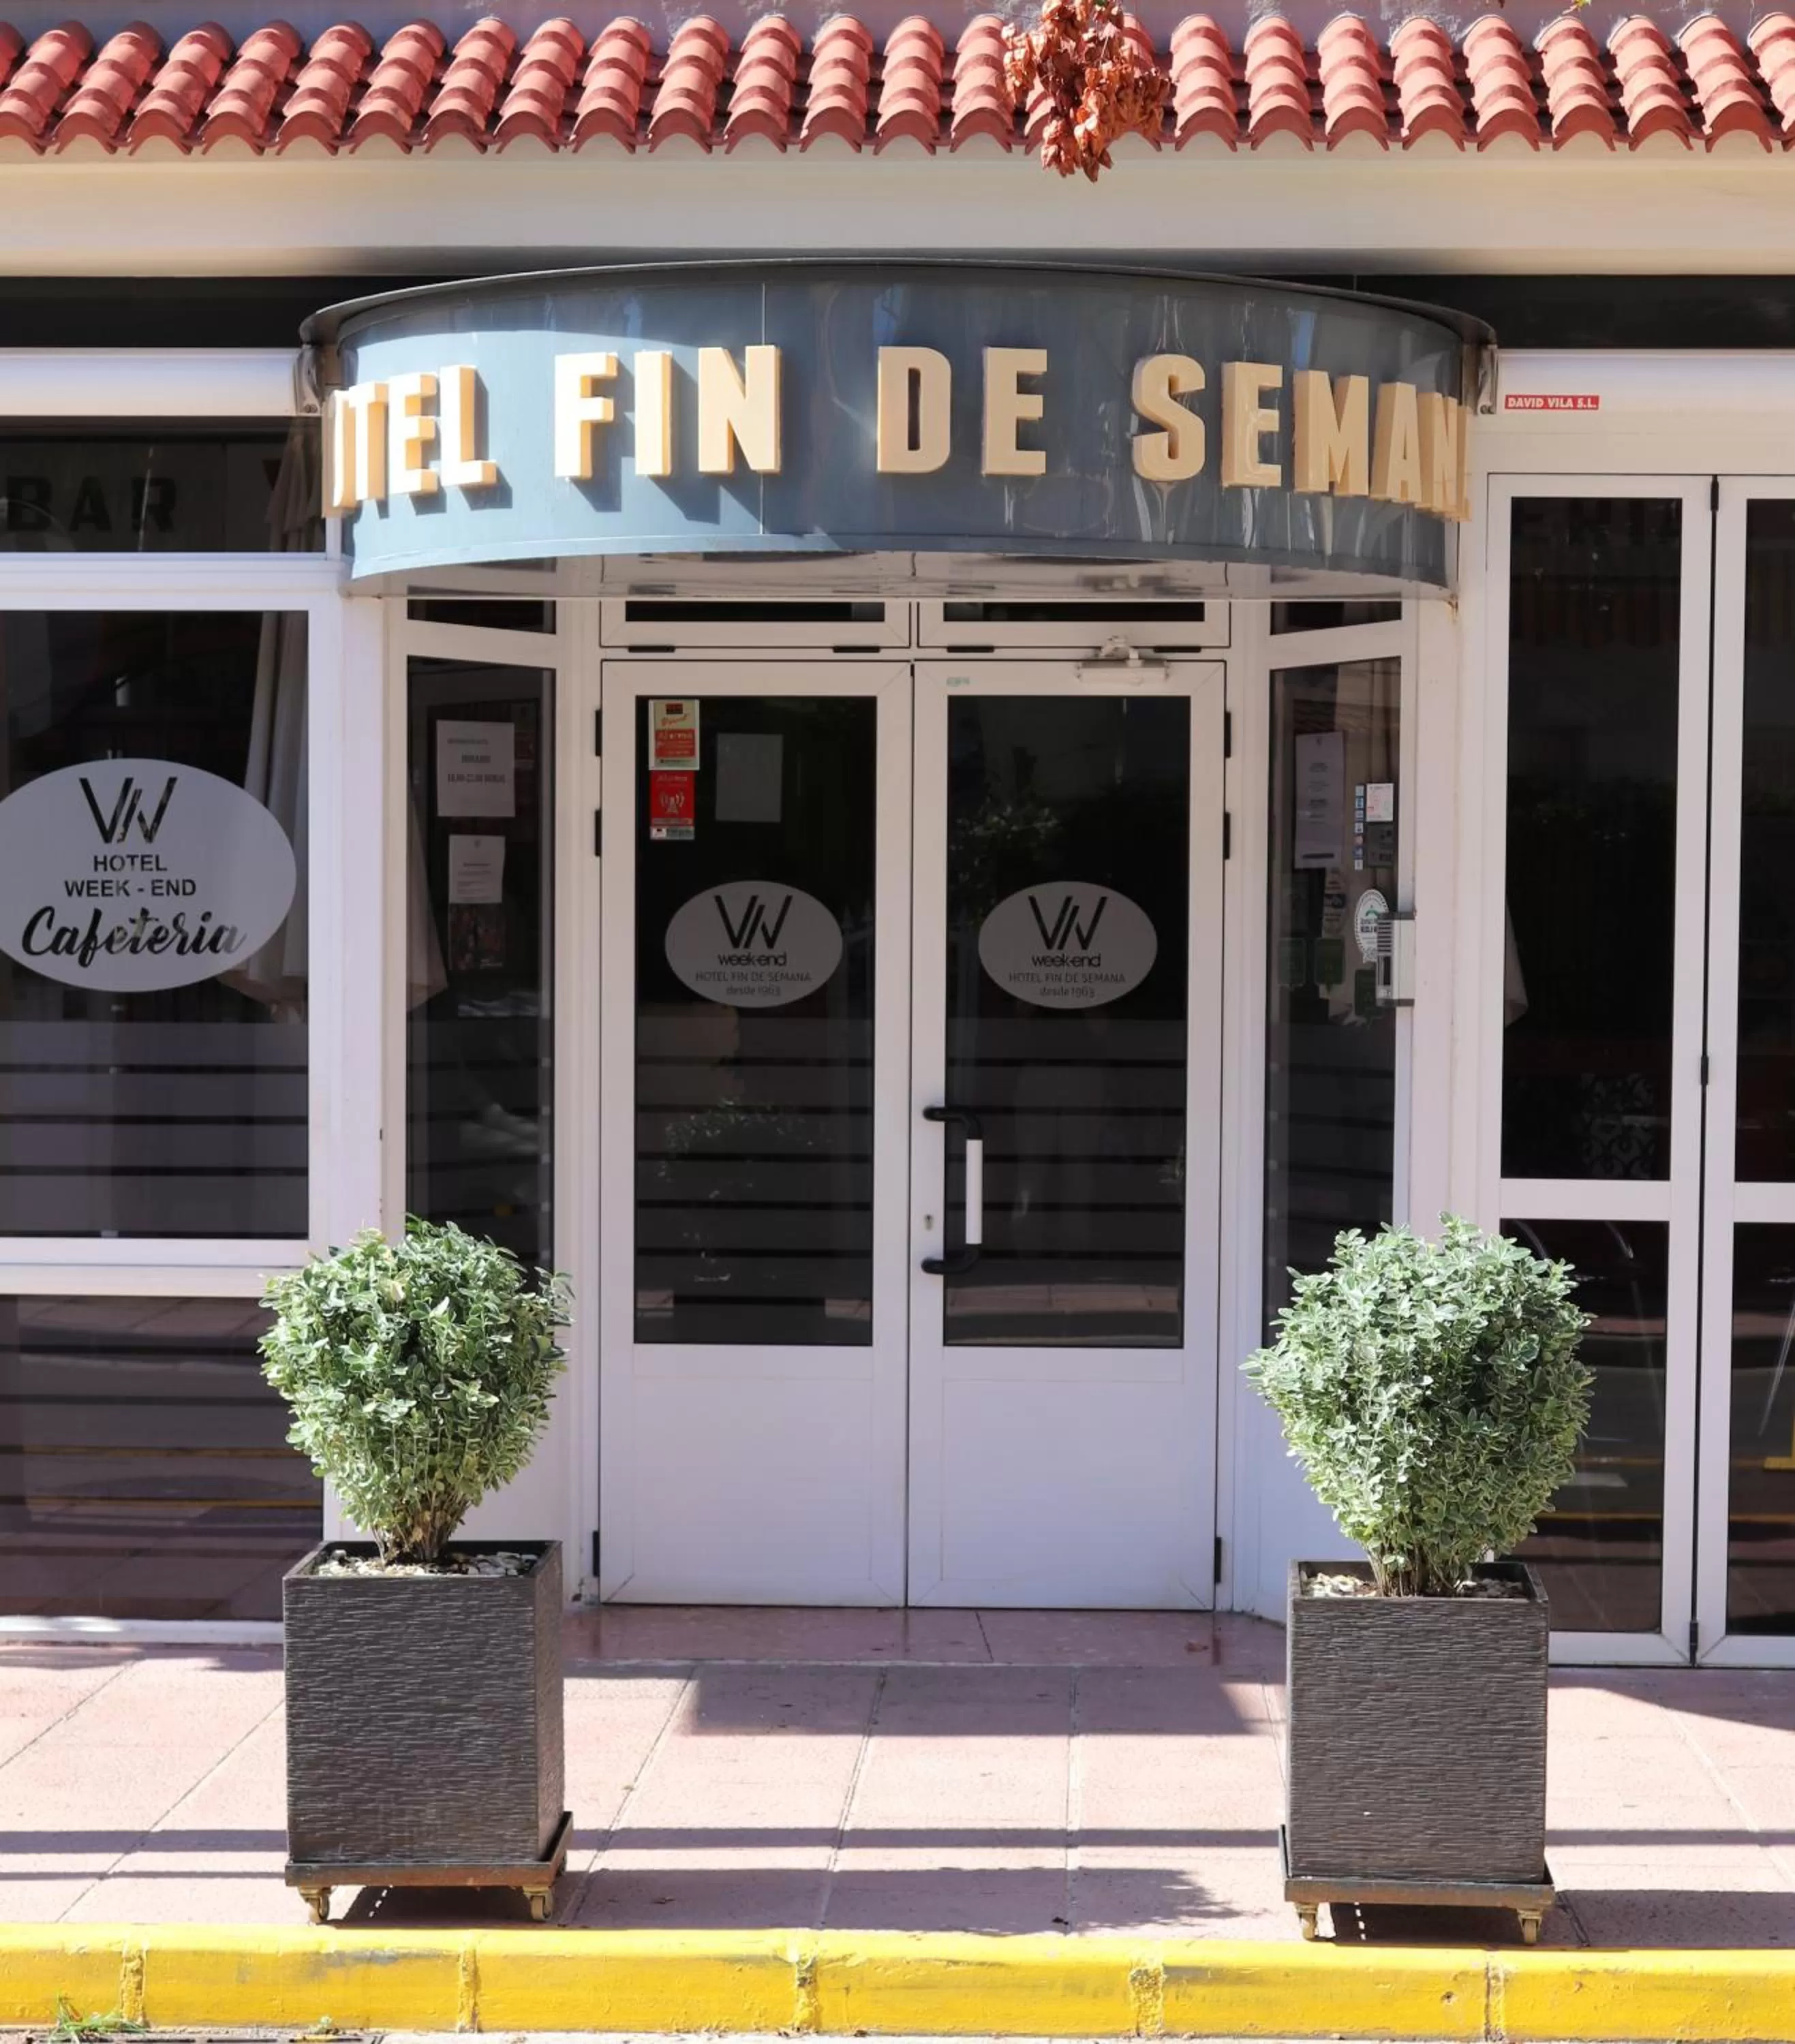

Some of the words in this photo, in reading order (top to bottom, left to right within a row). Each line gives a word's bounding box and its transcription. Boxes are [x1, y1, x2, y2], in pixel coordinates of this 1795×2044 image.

[1507, 397, 1544, 408] DAVID
[1548, 397, 1574, 408] VILA
[1577, 397, 1597, 408] S.L.
[322, 365, 497, 518] TEL
[554, 344, 781, 480] FIN
[877, 345, 1047, 476] DE
[1131, 354, 1472, 523] SEMAN
[6, 476, 177, 533] BAR
[93, 854, 168, 872] HOTEL
[21, 905, 247, 967] Cafeteria
[695, 971, 728, 982] HOTEL
[731, 971, 748, 982] FIN
[752, 971, 765, 982] DE
[769, 971, 812, 982] SEMANA
[1009, 972, 1041, 982] HOTEL
[1045, 972, 1062, 982] FIN
[1065, 972, 1079, 982] DE
[1081, 972, 1126, 982] SEMANA
